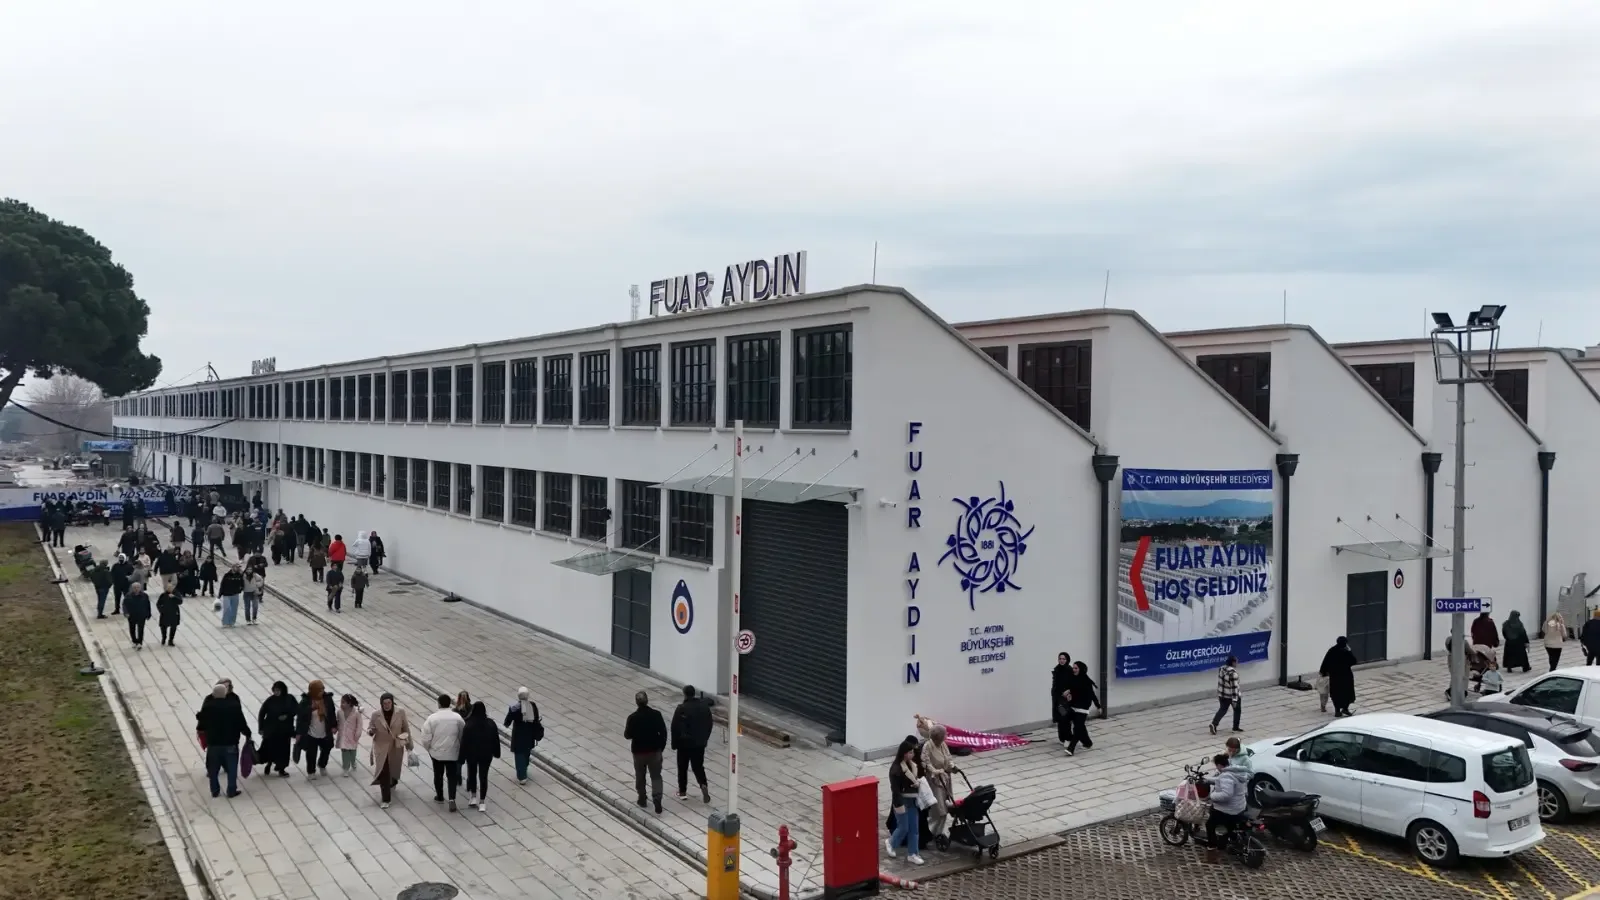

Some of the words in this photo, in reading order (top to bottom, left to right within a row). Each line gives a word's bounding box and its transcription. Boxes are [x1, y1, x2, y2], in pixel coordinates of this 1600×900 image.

[649, 271, 714, 317] FUAR
[721, 250, 807, 306] AYDIN
[908, 422, 923, 529] FUAR
[1140, 475, 1154, 484] T.C.
[1154, 475, 1178, 484] AYDIN
[1180, 474, 1227, 486] BÜYÜKŞEHİR
[1155, 545, 1206, 571] FUAR
[1210, 543, 1267, 568] AYDIN
[1154, 578, 1191, 605] HOŞ
[1194, 568, 1267, 598] GELDİNİZ
[1436, 600, 1479, 611] Otopark
[906, 551, 921, 684] AYDIN
[984, 624, 1004, 634] AYDIN
[960, 635, 1015, 652] BÜYÜKŞEHİR
[1165, 649, 1191, 660] ÖZLEM
[1192, 644, 1232, 659] ÇERÇİOĞLU
